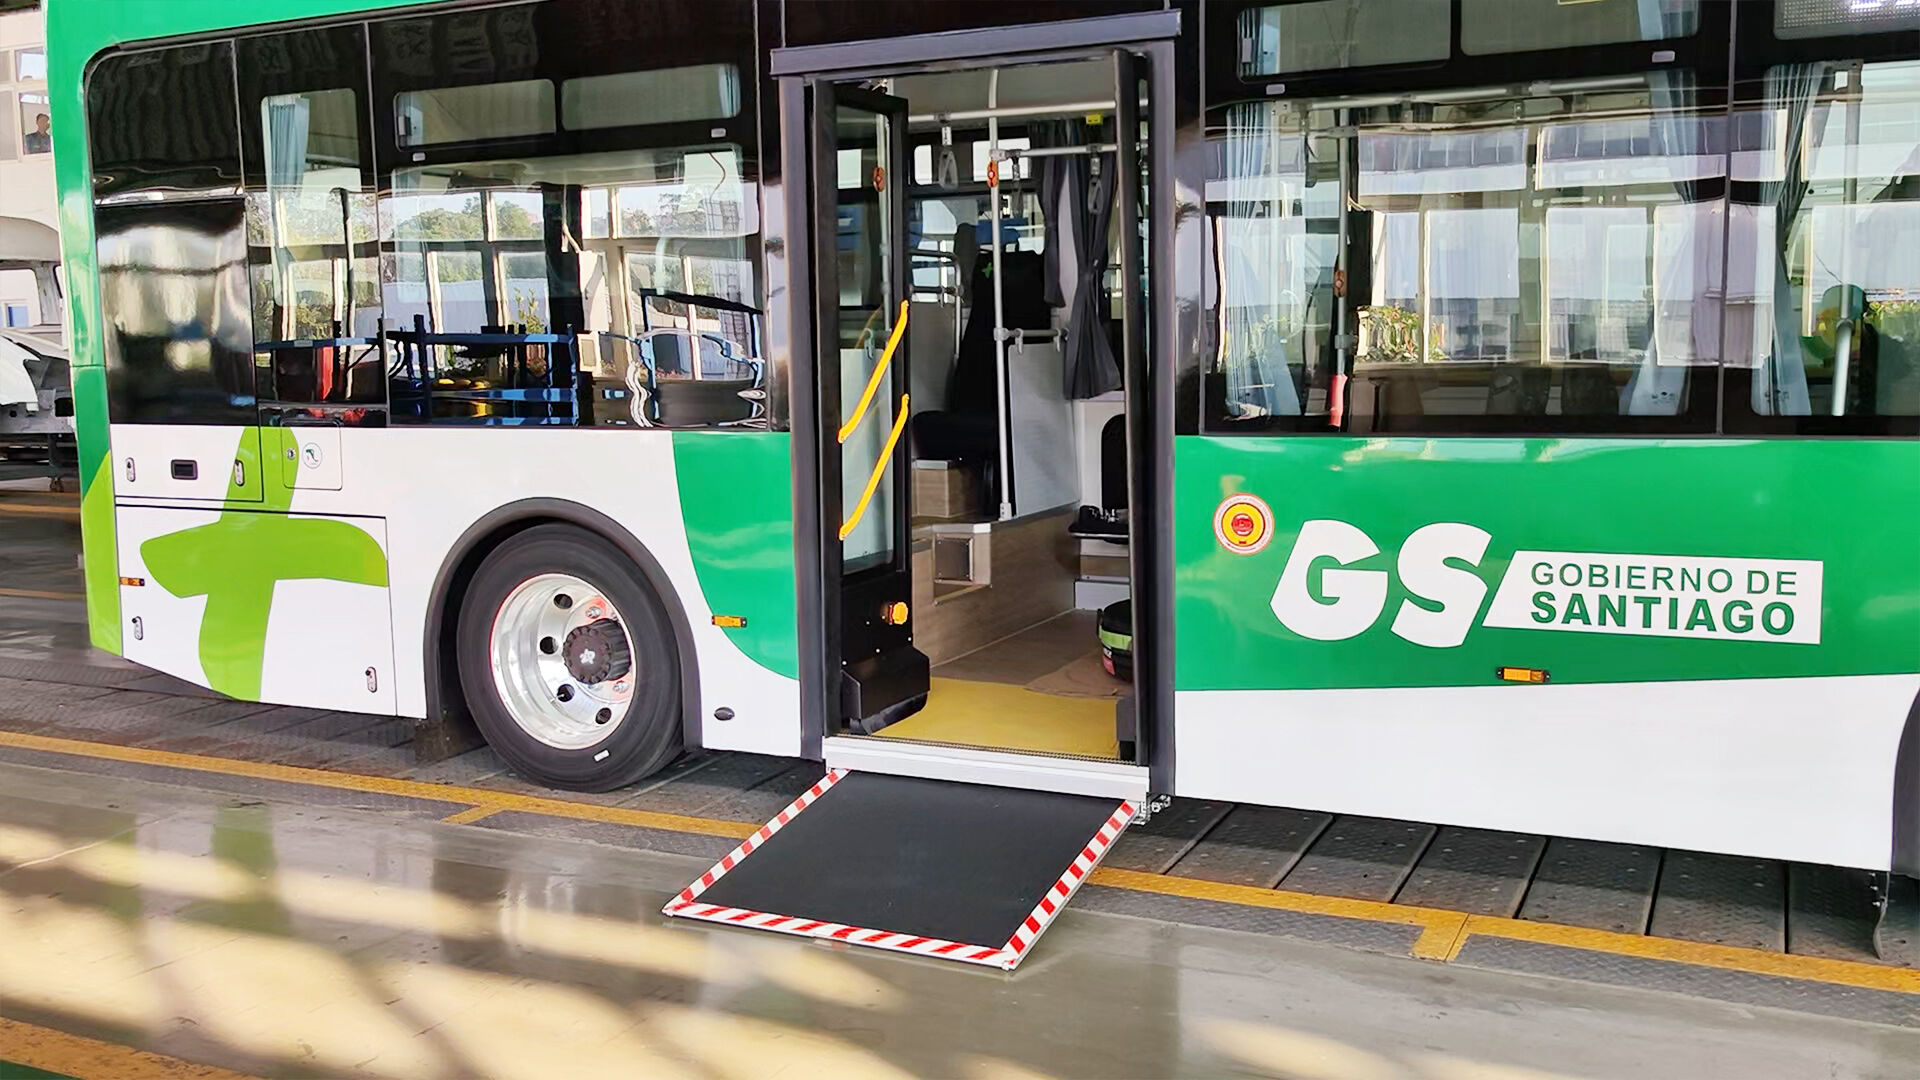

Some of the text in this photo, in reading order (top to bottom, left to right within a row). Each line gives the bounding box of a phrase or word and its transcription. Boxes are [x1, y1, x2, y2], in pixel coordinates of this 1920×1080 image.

[1270, 519, 1492, 647] GS
[1531, 561, 1797, 596] GOBIERNO DE
[1530, 591, 1796, 636] SANTIAGO
